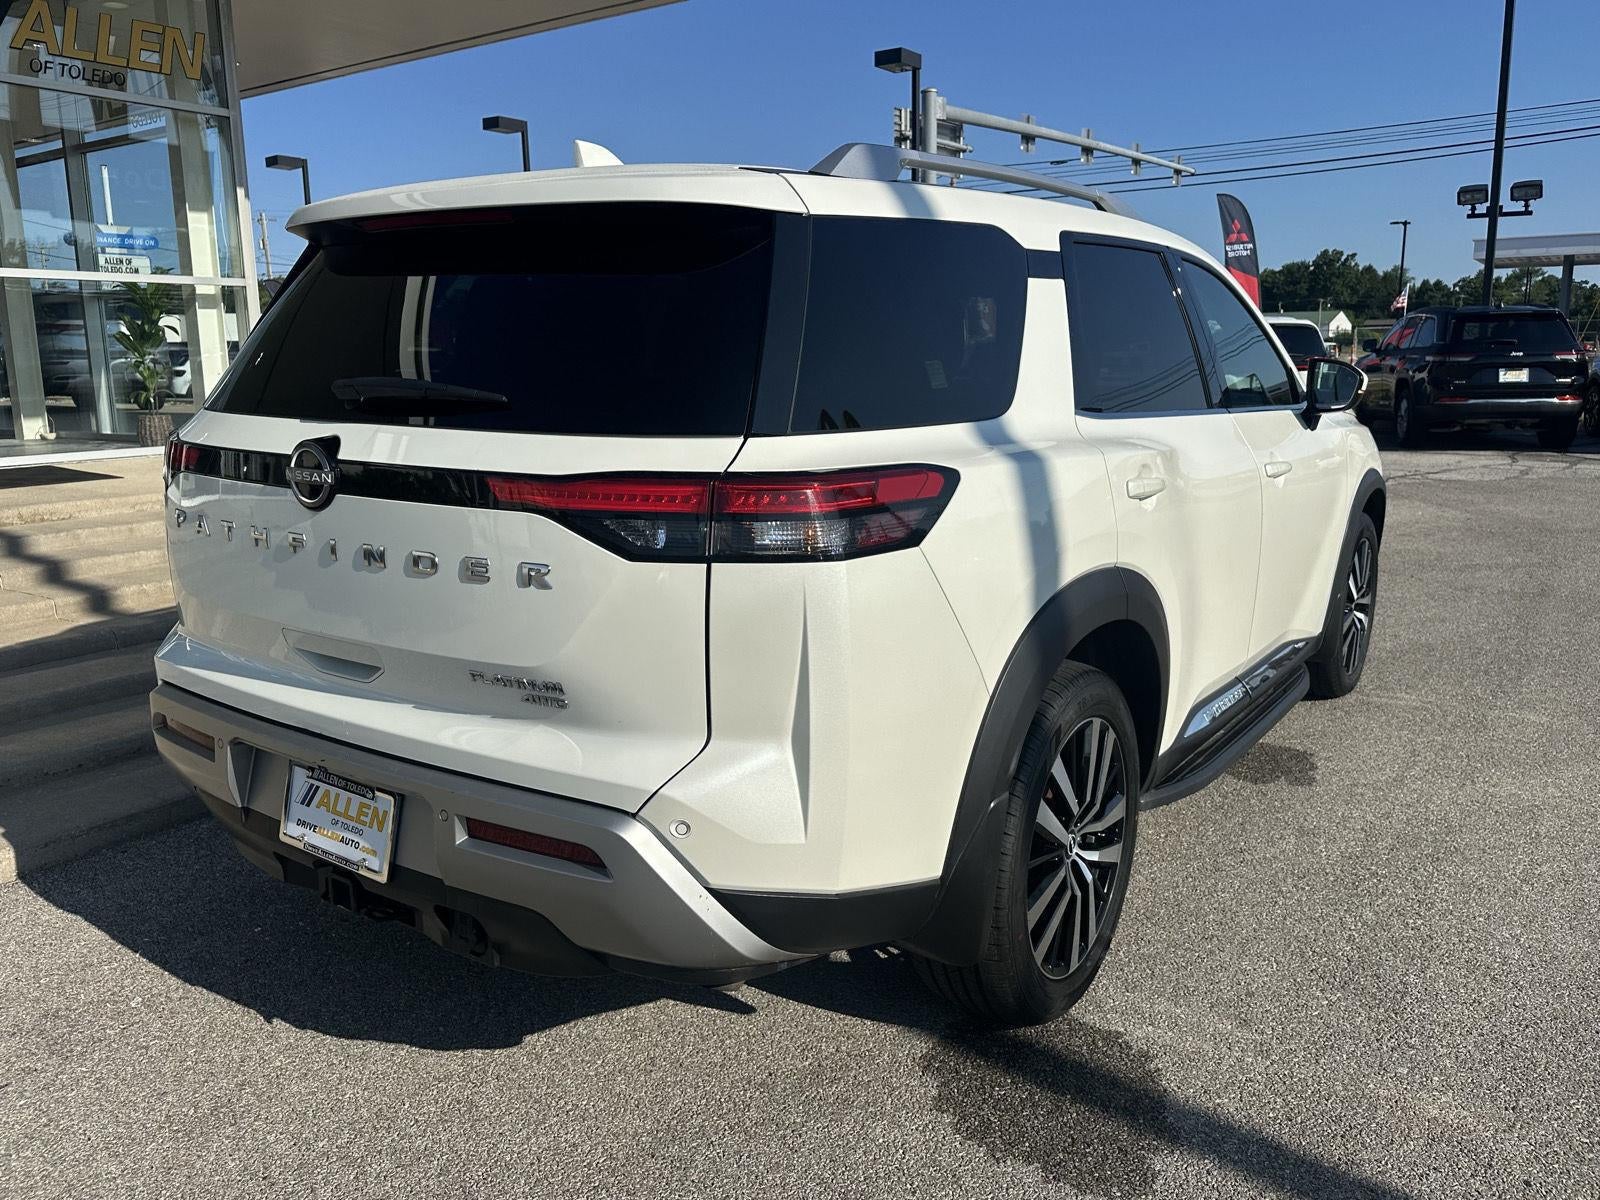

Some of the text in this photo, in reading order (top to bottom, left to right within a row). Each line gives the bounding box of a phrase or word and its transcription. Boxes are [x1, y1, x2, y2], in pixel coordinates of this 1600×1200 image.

[9, 0, 206, 81] ALLEN
[29, 57, 126, 87] OF TOLEDO
[124, 238, 143, 246] DRIVE
[144, 239, 156, 247] ON
[100, 265, 140, 274] TOLEDO.COM
[104, 256, 133, 266] ALLEN OF
[285, 467, 332, 484] NISSAN
[174, 507, 554, 591] PATHFINDER
[319, 769, 371, 797] ALLEN OF TOLEDO
[316, 788, 389, 833] ALLEN
[330, 818, 364, 837] OF TOLEDO
